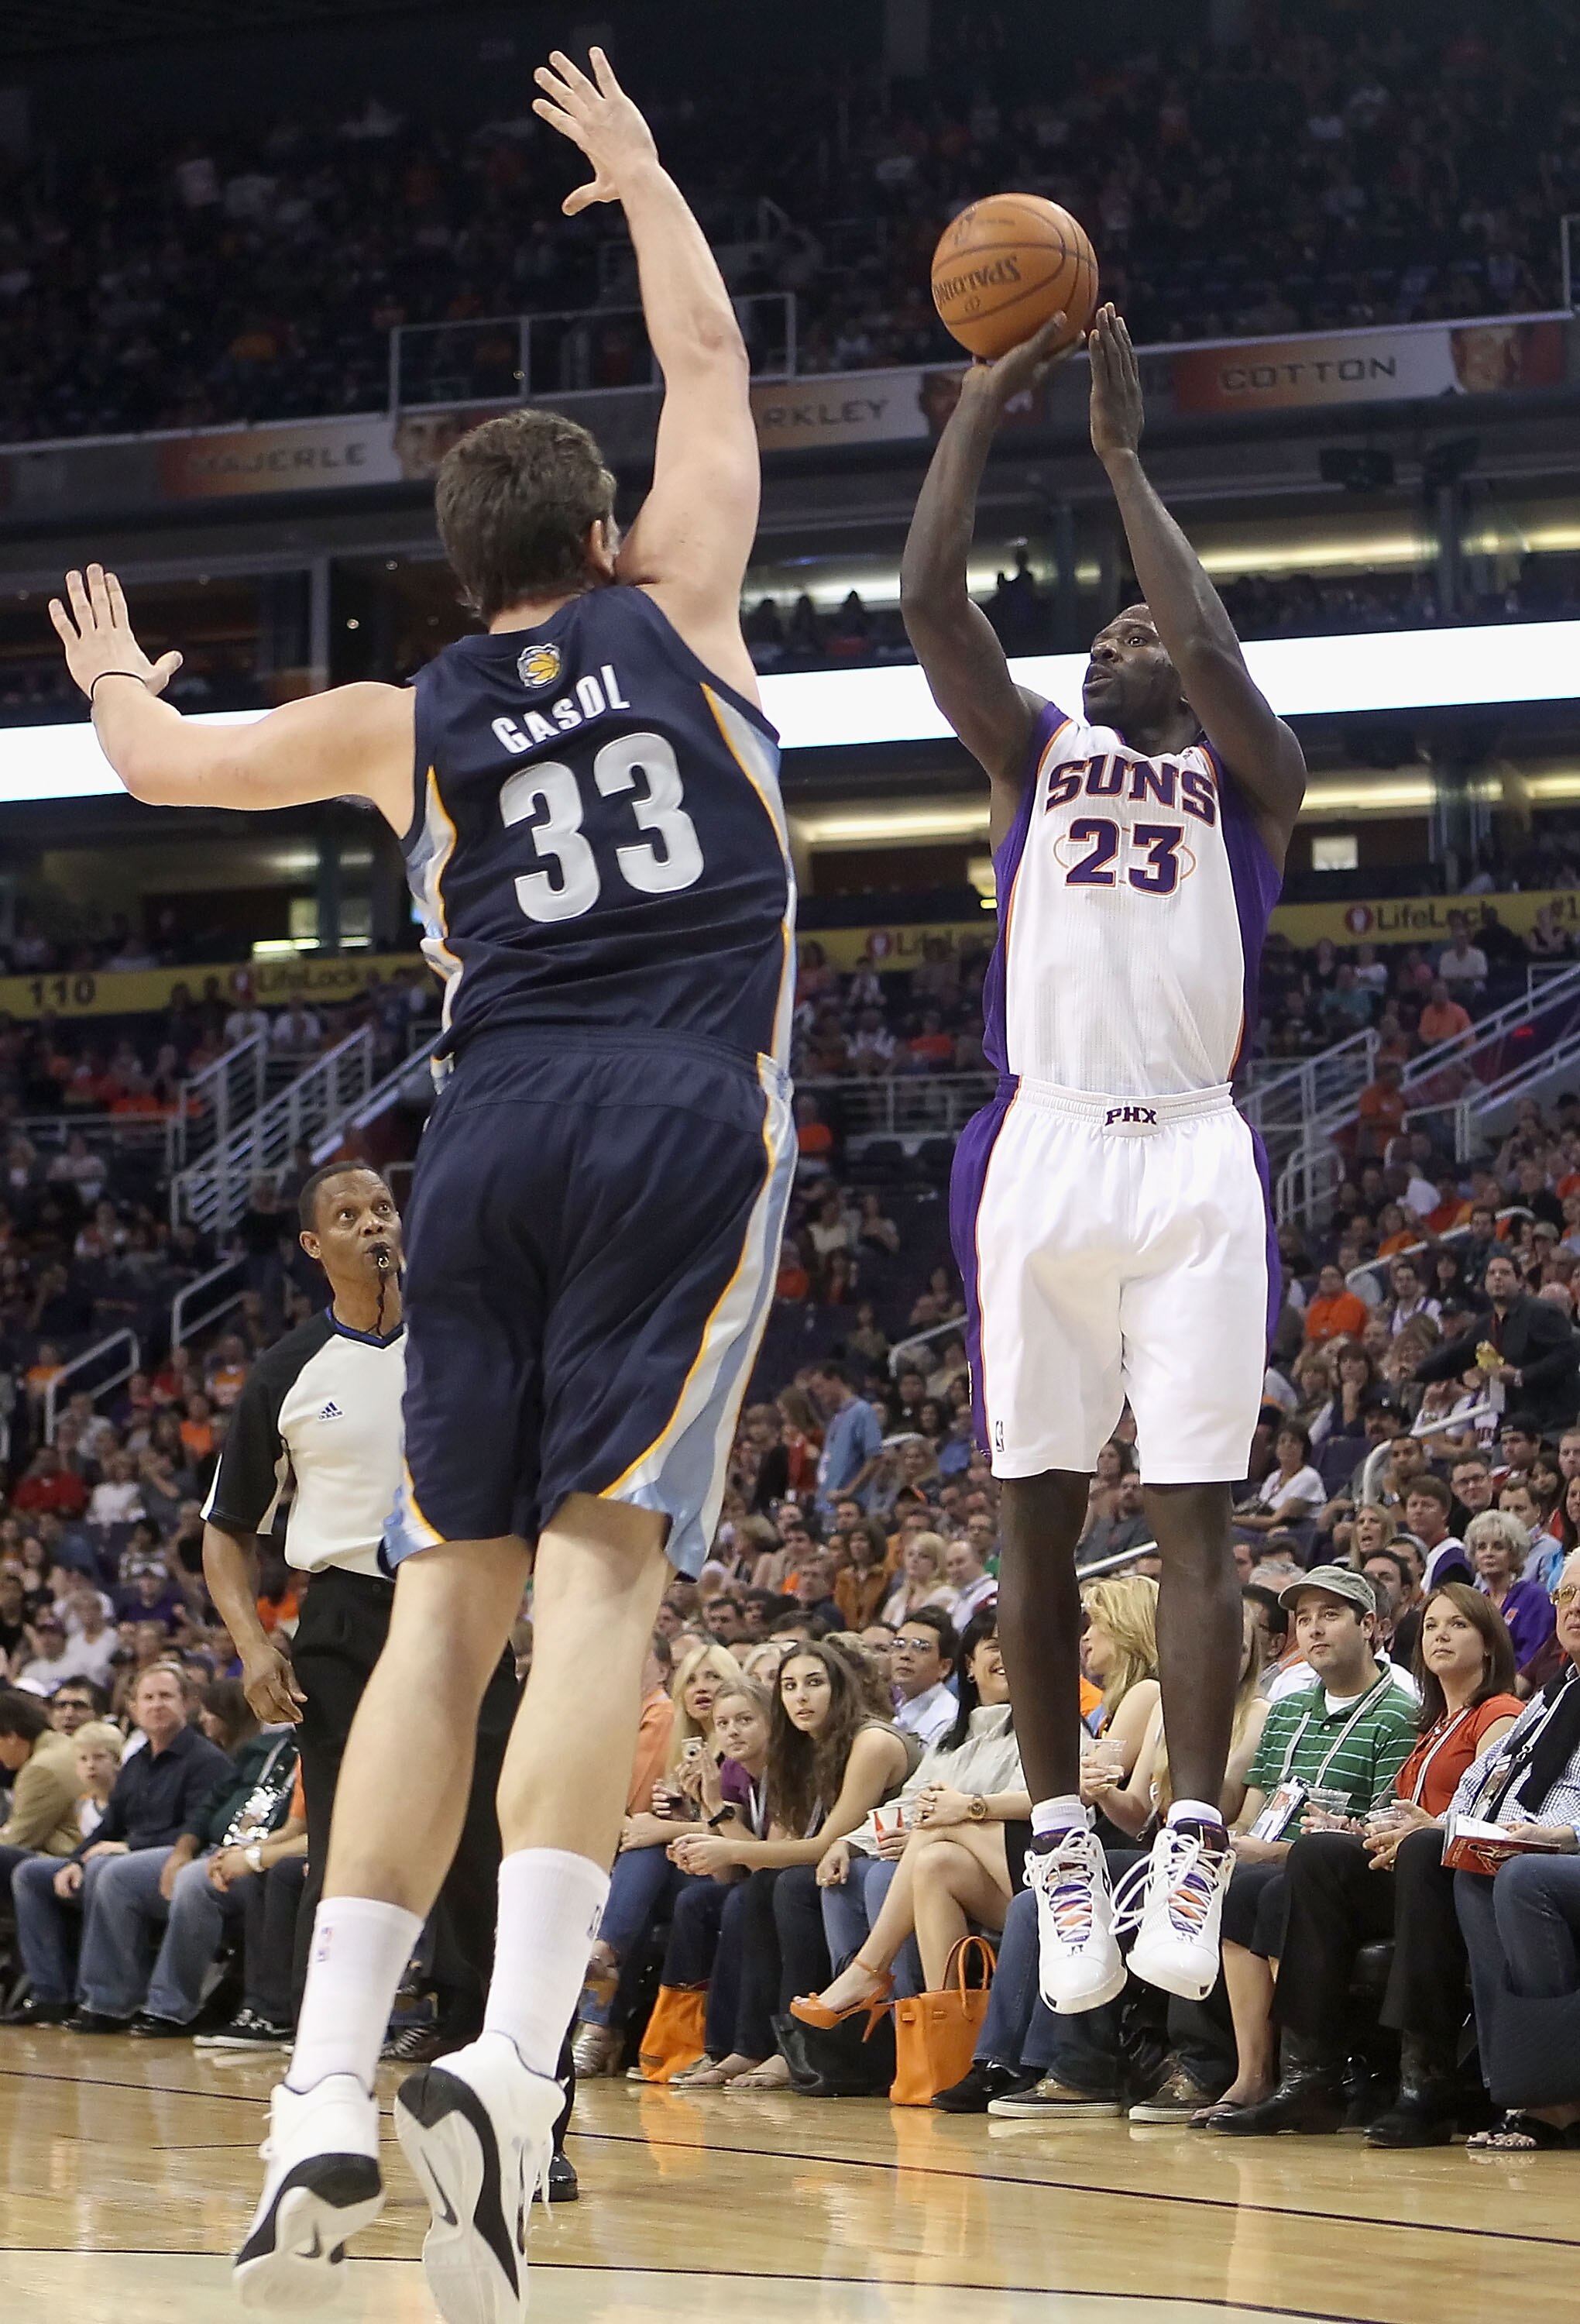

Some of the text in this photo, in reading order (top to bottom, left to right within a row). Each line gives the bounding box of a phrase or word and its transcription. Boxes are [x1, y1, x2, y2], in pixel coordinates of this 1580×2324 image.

[1221, 357, 1396, 391] COTTON
[491, 665, 630, 755] GASOL
[1045, 755, 1216, 827] SUNS
[500, 732, 705, 923] 33
[1065, 818, 1185, 896] 23
[1377, 900, 1489, 930] LifeLc
[30, 977, 96, 1006] 110
[1104, 1106, 1157, 1126] PHX
